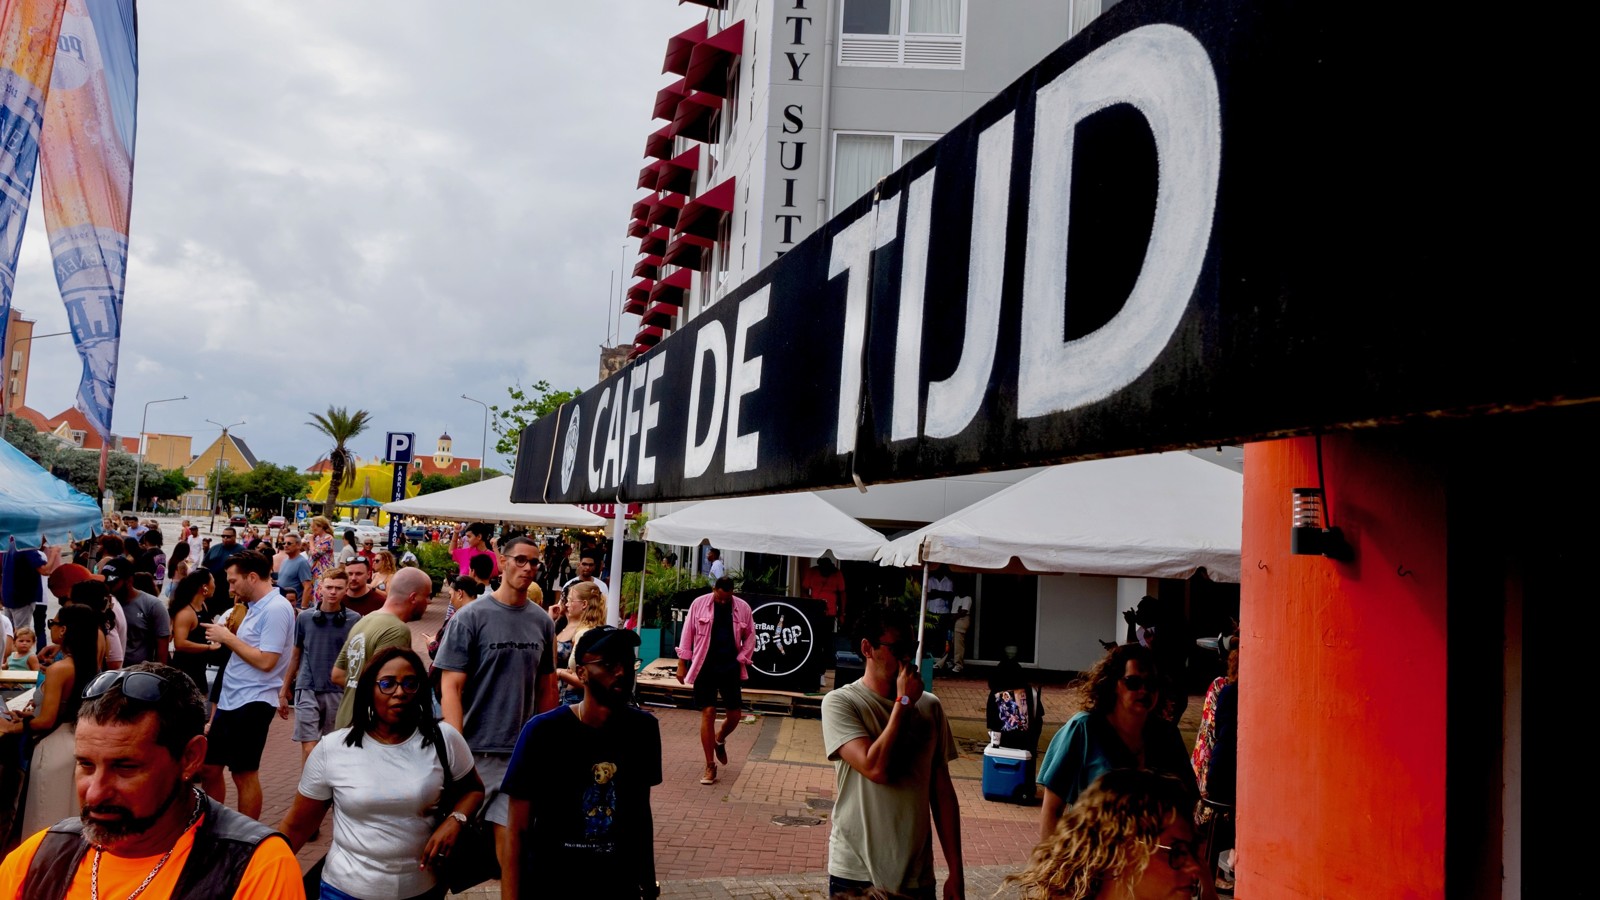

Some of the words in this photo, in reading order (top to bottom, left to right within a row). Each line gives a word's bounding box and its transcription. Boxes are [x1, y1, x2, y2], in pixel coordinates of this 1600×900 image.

[775, 104, 807, 261] SUIT
[588, 350, 666, 493] CAFE
[684, 284, 771, 478] DE
[828, 23, 1222, 455] TIJD
[390, 434, 410, 461] P
[489, 641, 540, 650] carhartt
